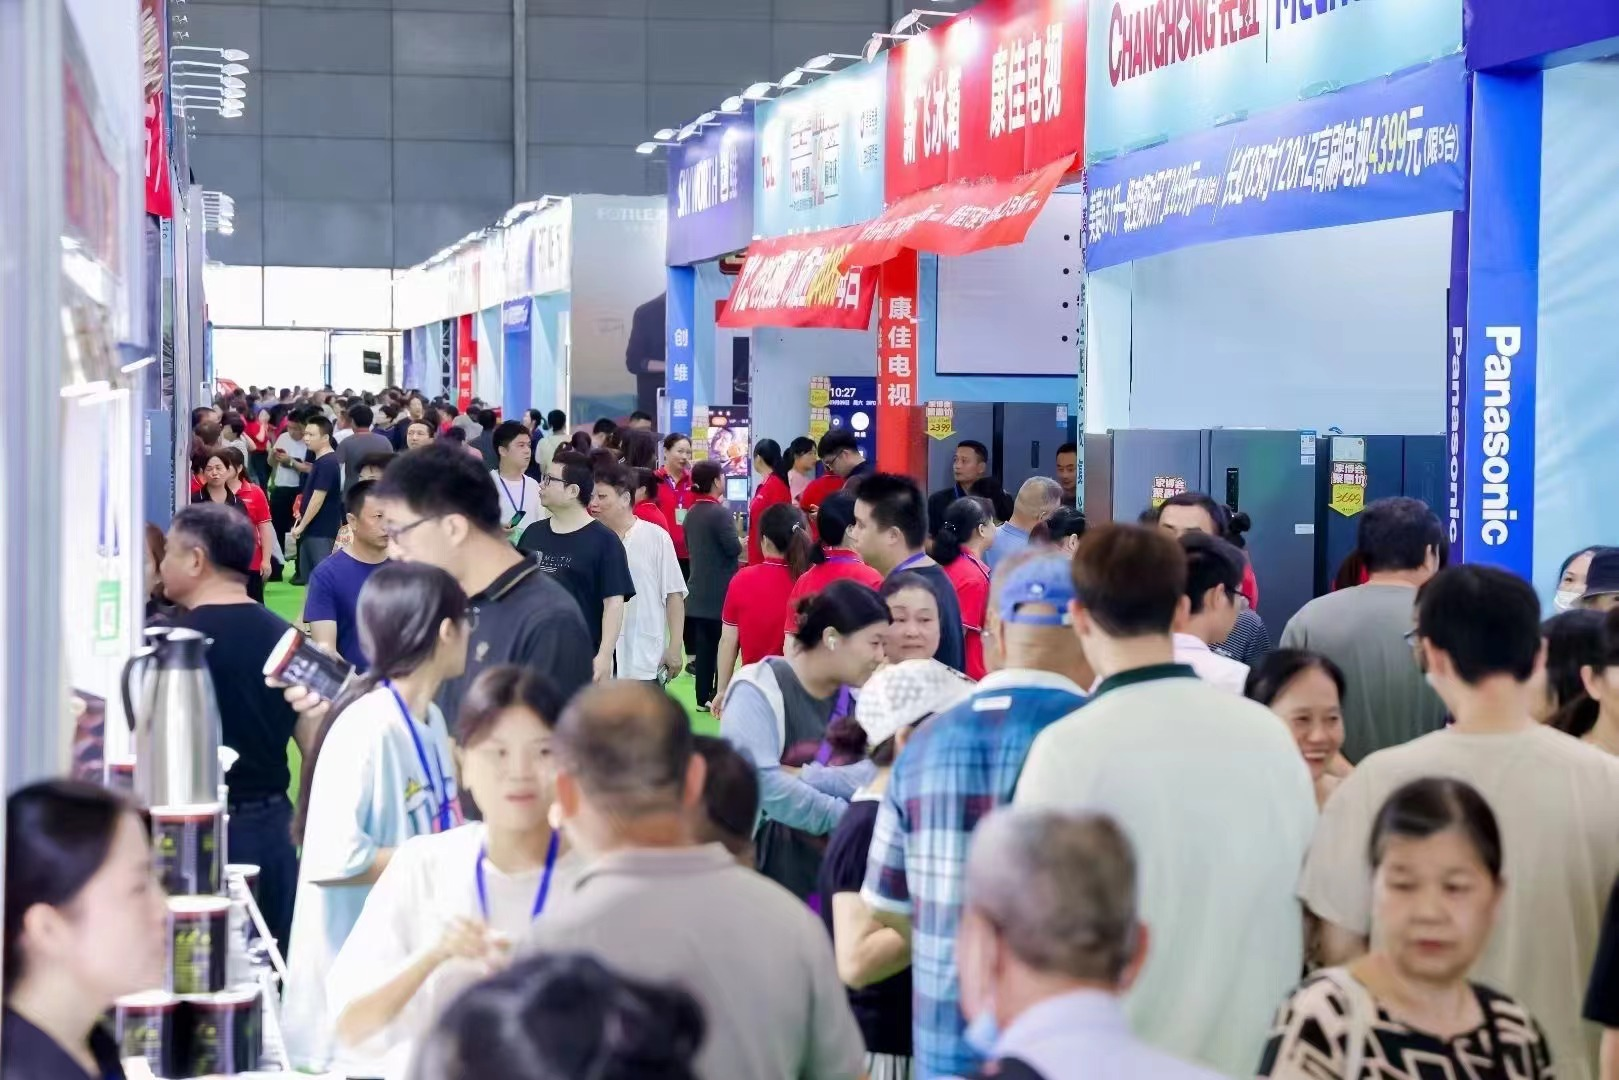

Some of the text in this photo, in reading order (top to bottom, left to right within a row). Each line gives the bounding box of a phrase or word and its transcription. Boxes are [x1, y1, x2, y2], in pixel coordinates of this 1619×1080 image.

[989, 23, 1063, 139] 康佳电视
[830, 387, 857, 398] 10:27
[888, 296, 912, 406] 康佳电视
[1450, 326, 1463, 544] Panasonic
[1481, 326, 1521, 546] Panasonic
